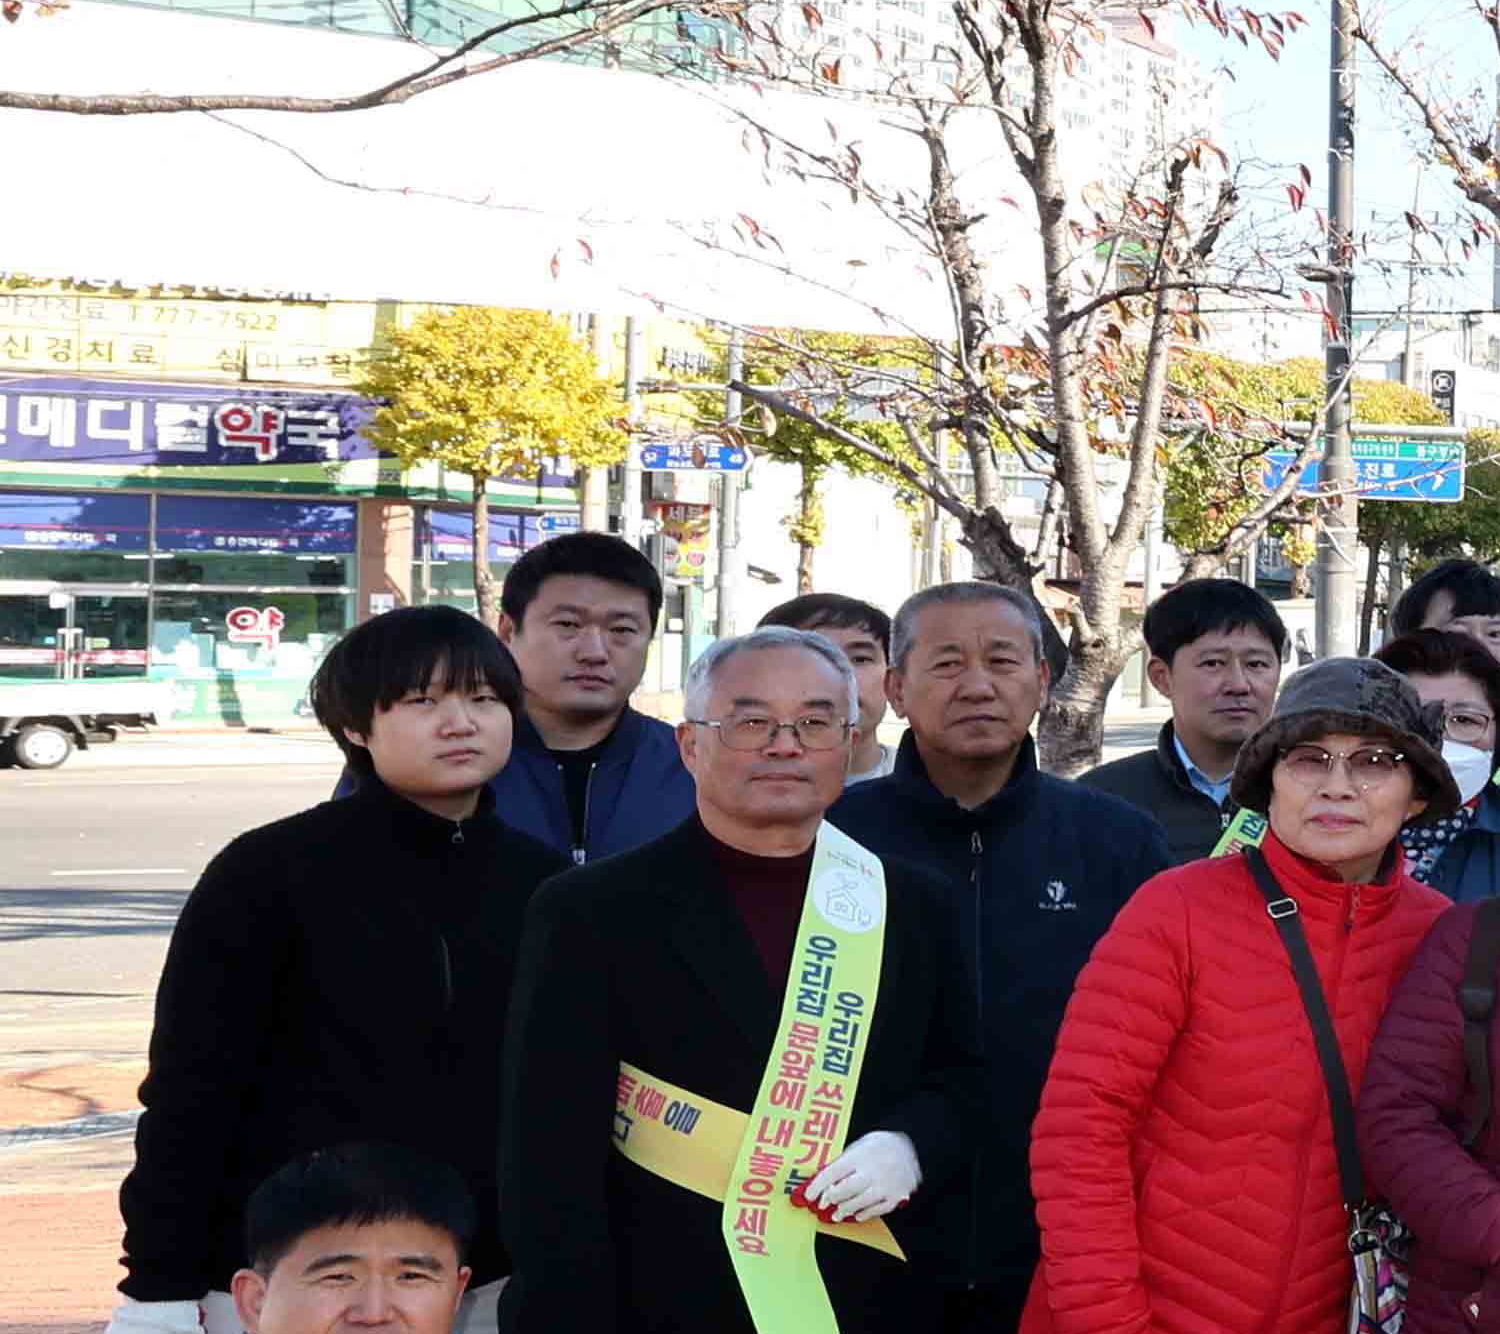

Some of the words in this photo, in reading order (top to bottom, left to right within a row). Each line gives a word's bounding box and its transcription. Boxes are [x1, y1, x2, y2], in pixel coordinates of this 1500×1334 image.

[0, 393, 340, 462] 메디컬약국
[225, 606, 286, 654] 약
[796, 934, 837, 1020] 우리집
[769, 1020, 820, 1110] 문앞에
[822, 991, 864, 1077] 우리집
